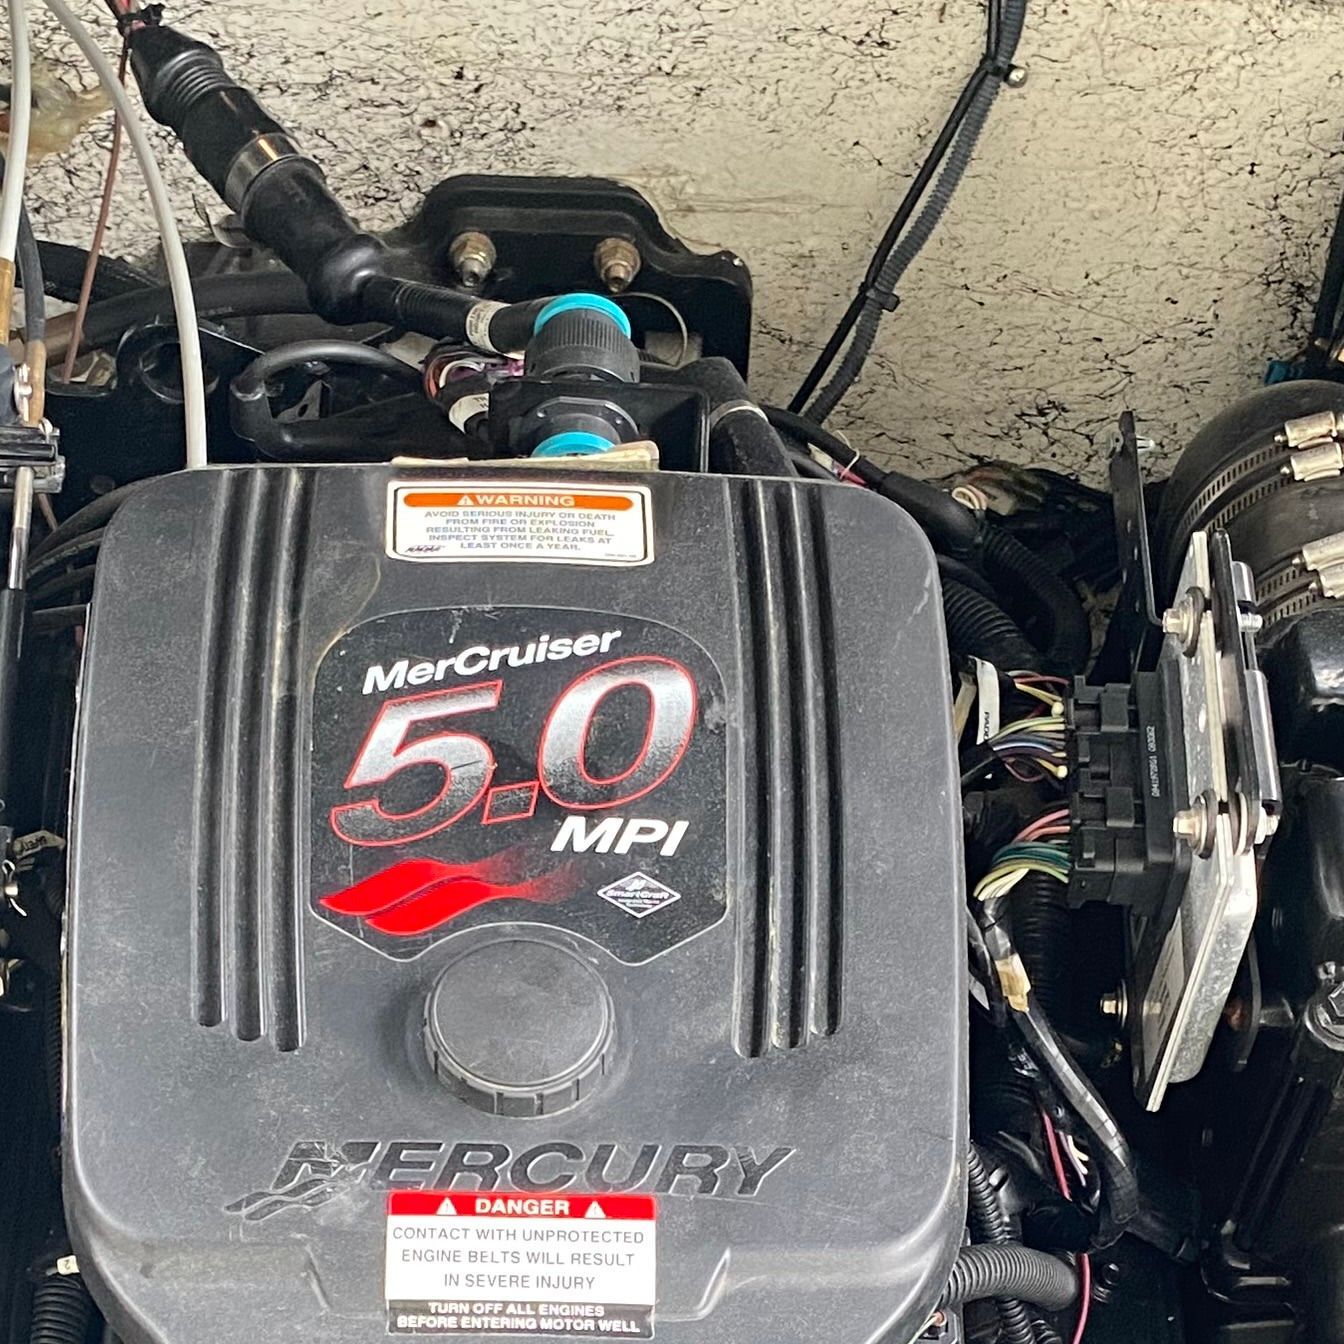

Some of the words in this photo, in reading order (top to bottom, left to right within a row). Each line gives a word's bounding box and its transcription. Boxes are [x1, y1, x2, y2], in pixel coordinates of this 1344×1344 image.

[476, 494, 575, 507] WARNING
[530, 519, 595, 528] EXPLOSION
[578, 513, 616, 521] DEATH
[529, 527, 579, 535] LEAKING
[362, 629, 622, 695] MerCruiser
[330, 655, 698, 847] 5.0
[551, 815, 690, 857] MPI
[269, 1140, 797, 1197] MERCURY
[475, 1198, 570, 1215] DANGER
[393, 1227, 470, 1240] CONTACT
[476, 1228, 517, 1241] WITH
[523, 1229, 644, 1244] UNPROTECTED
[402, 1249, 462, 1262] ENGINE
[468, 1250, 521, 1264] BELTS
[527, 1251, 565, 1265] WILL
[571, 1252, 635, 1266] RESULT
[444, 1273, 459, 1287] IN
[465, 1273, 530, 1288] SEVERE
[536, 1275, 595, 1290] INJURY
[428, 1302, 469, 1314] TURN
[472, 1302, 503, 1315] OFF
[506, 1303, 535, 1315] ALL
[538, 1304, 605, 1317] ENGINES
[396, 1314, 458, 1328] BEFORE
[460, 1316, 537, 1330] ENTERING
[539, 1318, 595, 1331] MOTOR
[597, 1319, 641, 1333] WELL
